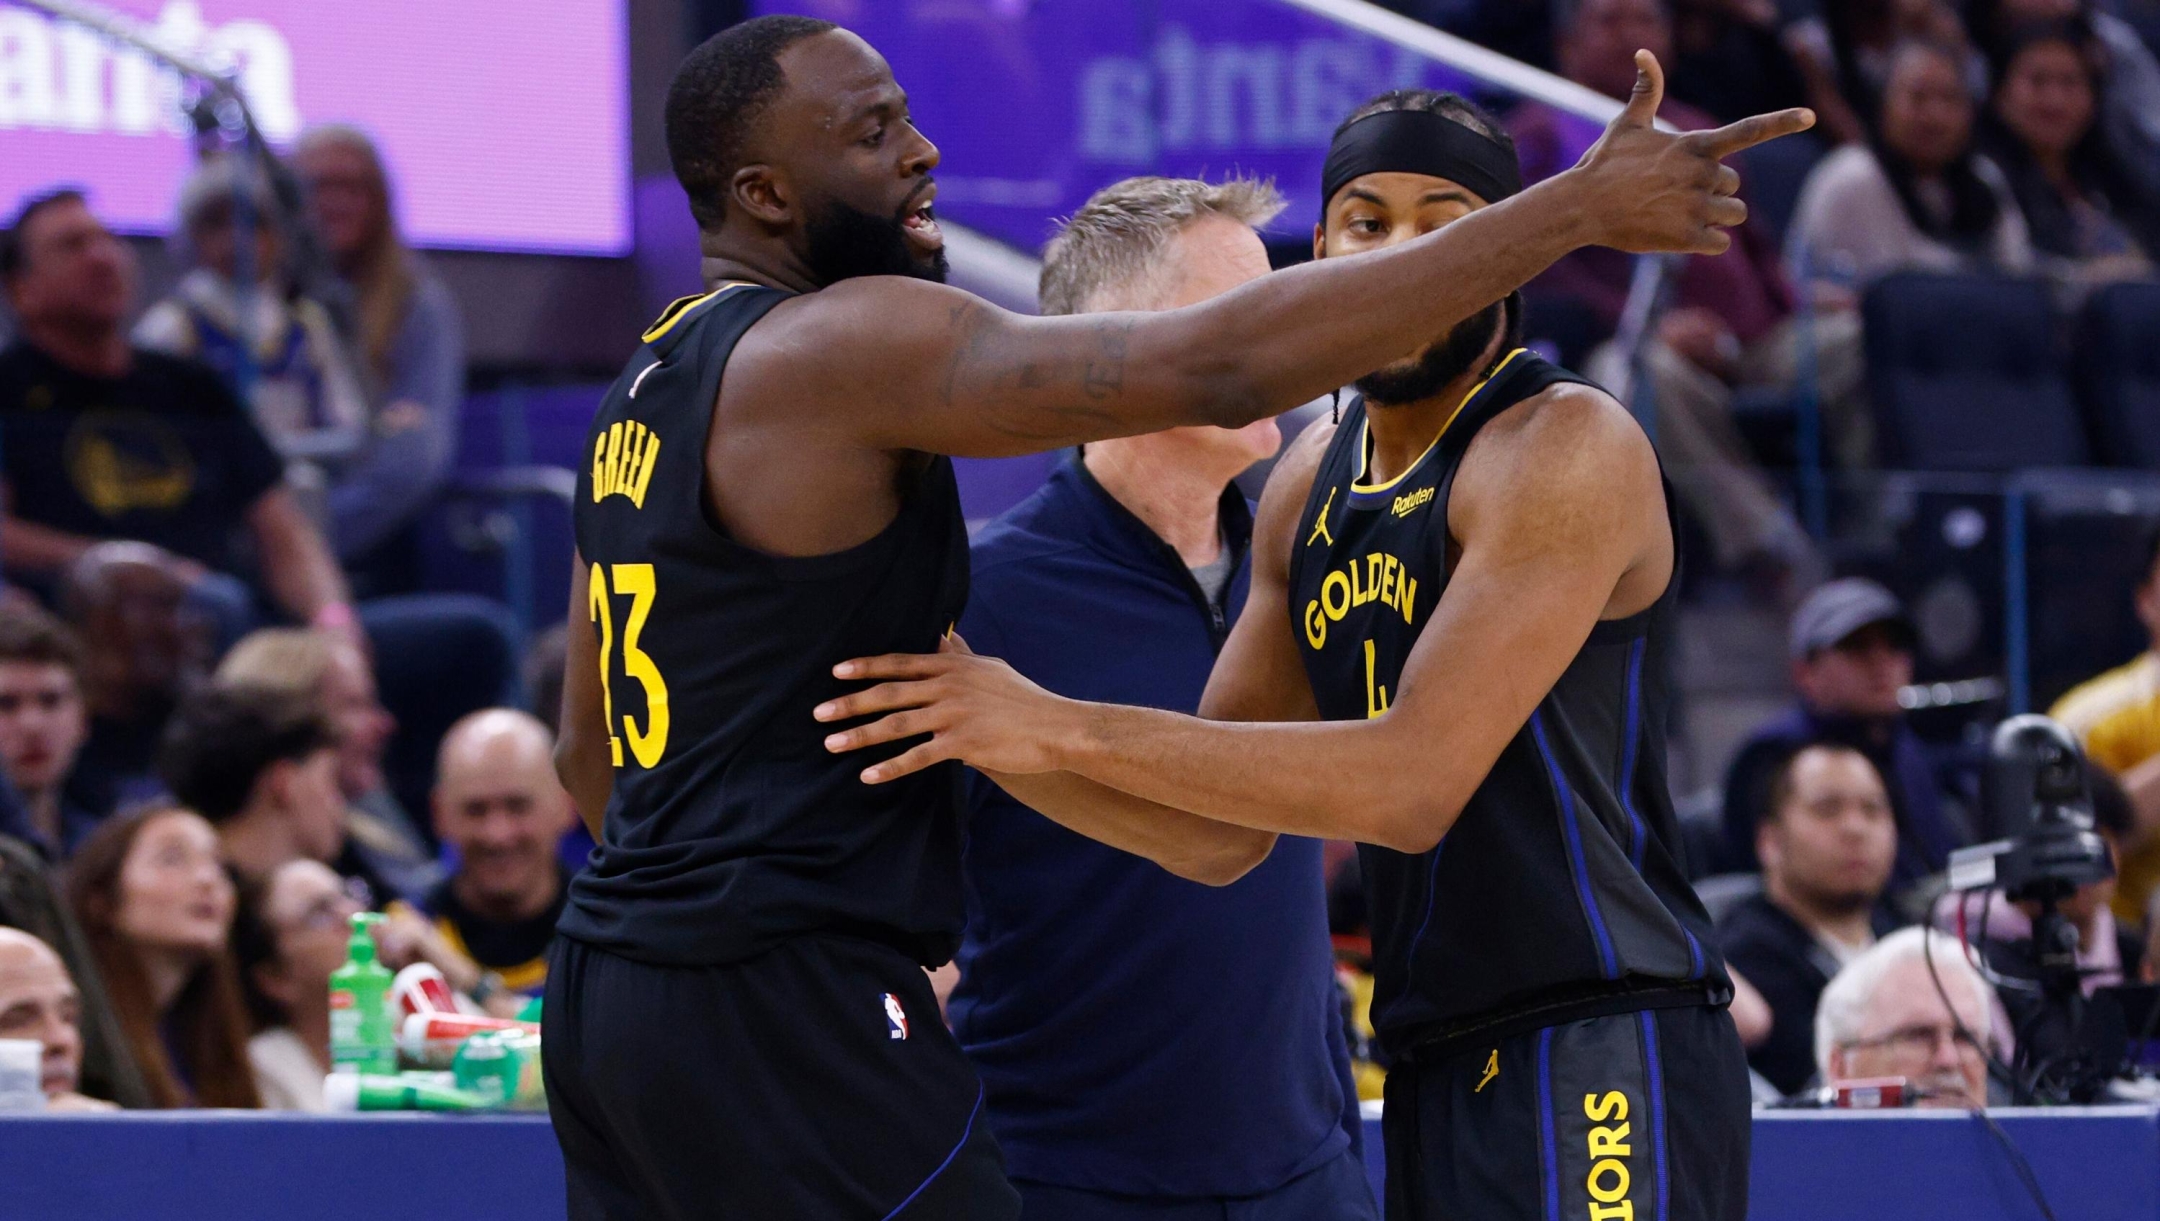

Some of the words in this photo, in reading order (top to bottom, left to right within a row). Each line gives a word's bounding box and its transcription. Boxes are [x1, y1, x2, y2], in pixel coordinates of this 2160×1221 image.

[593, 419, 661, 510] GREEN
[1391, 486, 1434, 516] Rakuten
[1305, 552, 1417, 650] GOLDEN
[589, 562, 670, 769] 23
